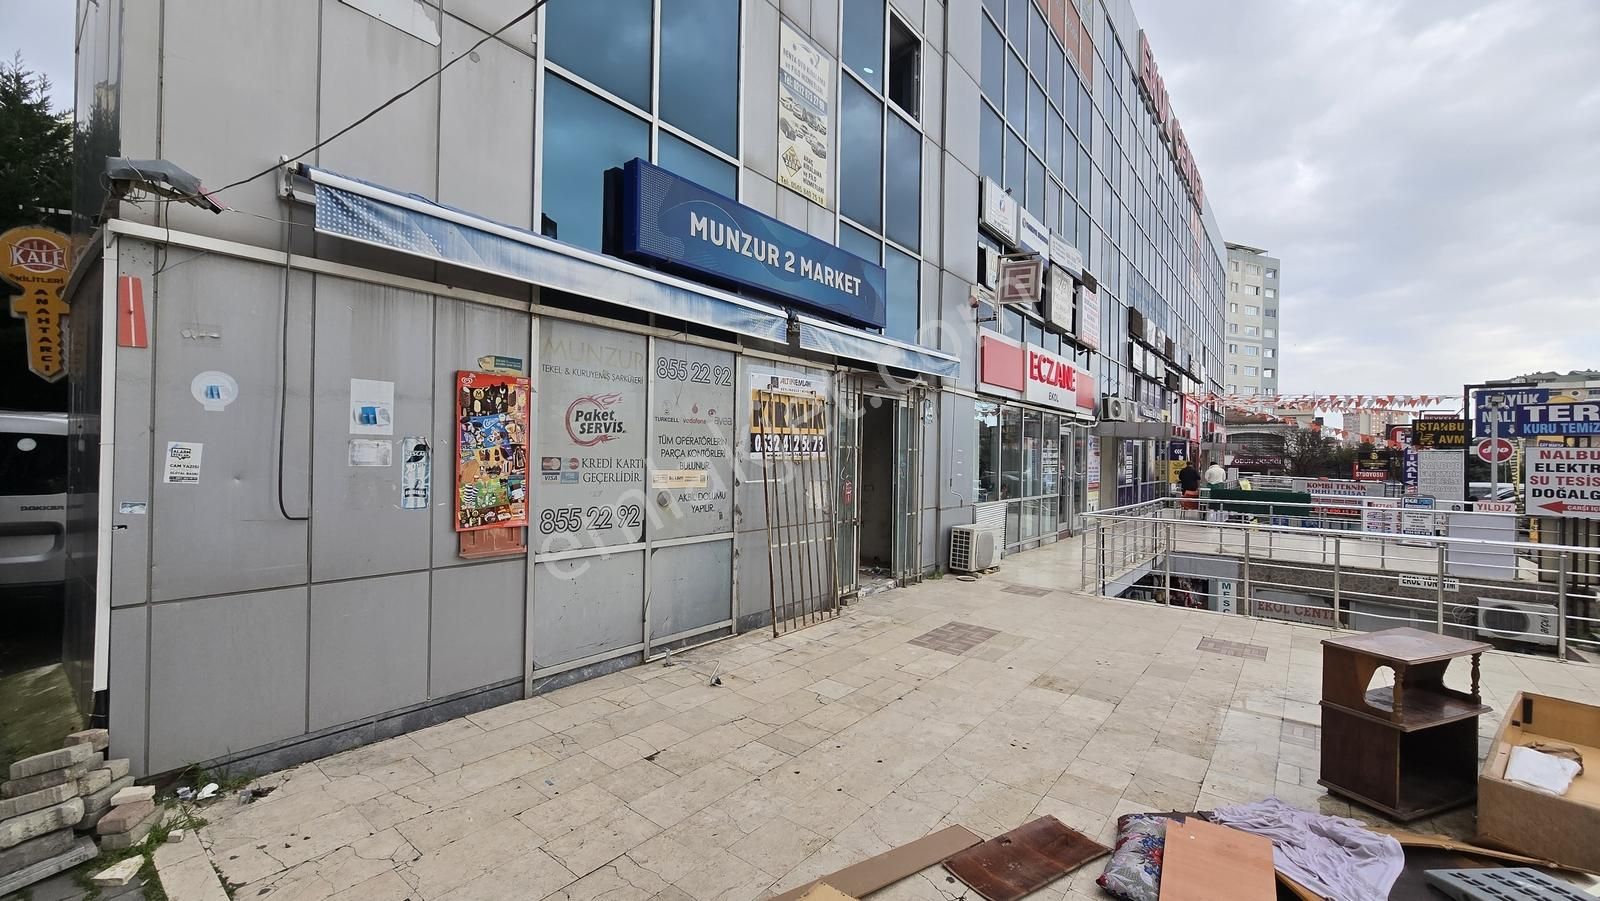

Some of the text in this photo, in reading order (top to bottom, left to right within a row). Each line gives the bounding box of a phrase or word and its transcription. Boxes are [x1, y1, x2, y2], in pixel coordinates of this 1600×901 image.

[12, 245, 65, 267] KALE
[689, 211, 862, 297] MUNZUR 2 MARKET
[542, 364, 562, 375] TEKEL
[564, 367, 571, 376] &
[656, 356, 732, 387] 855 22 92
[1029, 350, 1076, 393] ECZANE
[575, 408, 616, 422] Paket
[1415, 421, 1465, 431] İSTANBU
[1523, 421, 1600, 434] KURU TEMİZ
[658, 434, 674, 446] TÜM
[1439, 435, 1465, 444] AVM
[660, 448, 686, 459] PARÇA
[1539, 450, 1600, 461] NALBU
[581, 457, 613, 469] KREDİ
[1535, 463, 1600, 474] ELEKTR
[1530, 475, 1550, 486] SU
[1531, 486, 1600, 501] DOĞALG
[1476, 503, 1512, 512] YILDIZ
[540, 504, 641, 534] 855 22 92
[1402, 575, 1457, 590] EKOL YÖNTİM
[1257, 601, 1290, 615] EKOL
